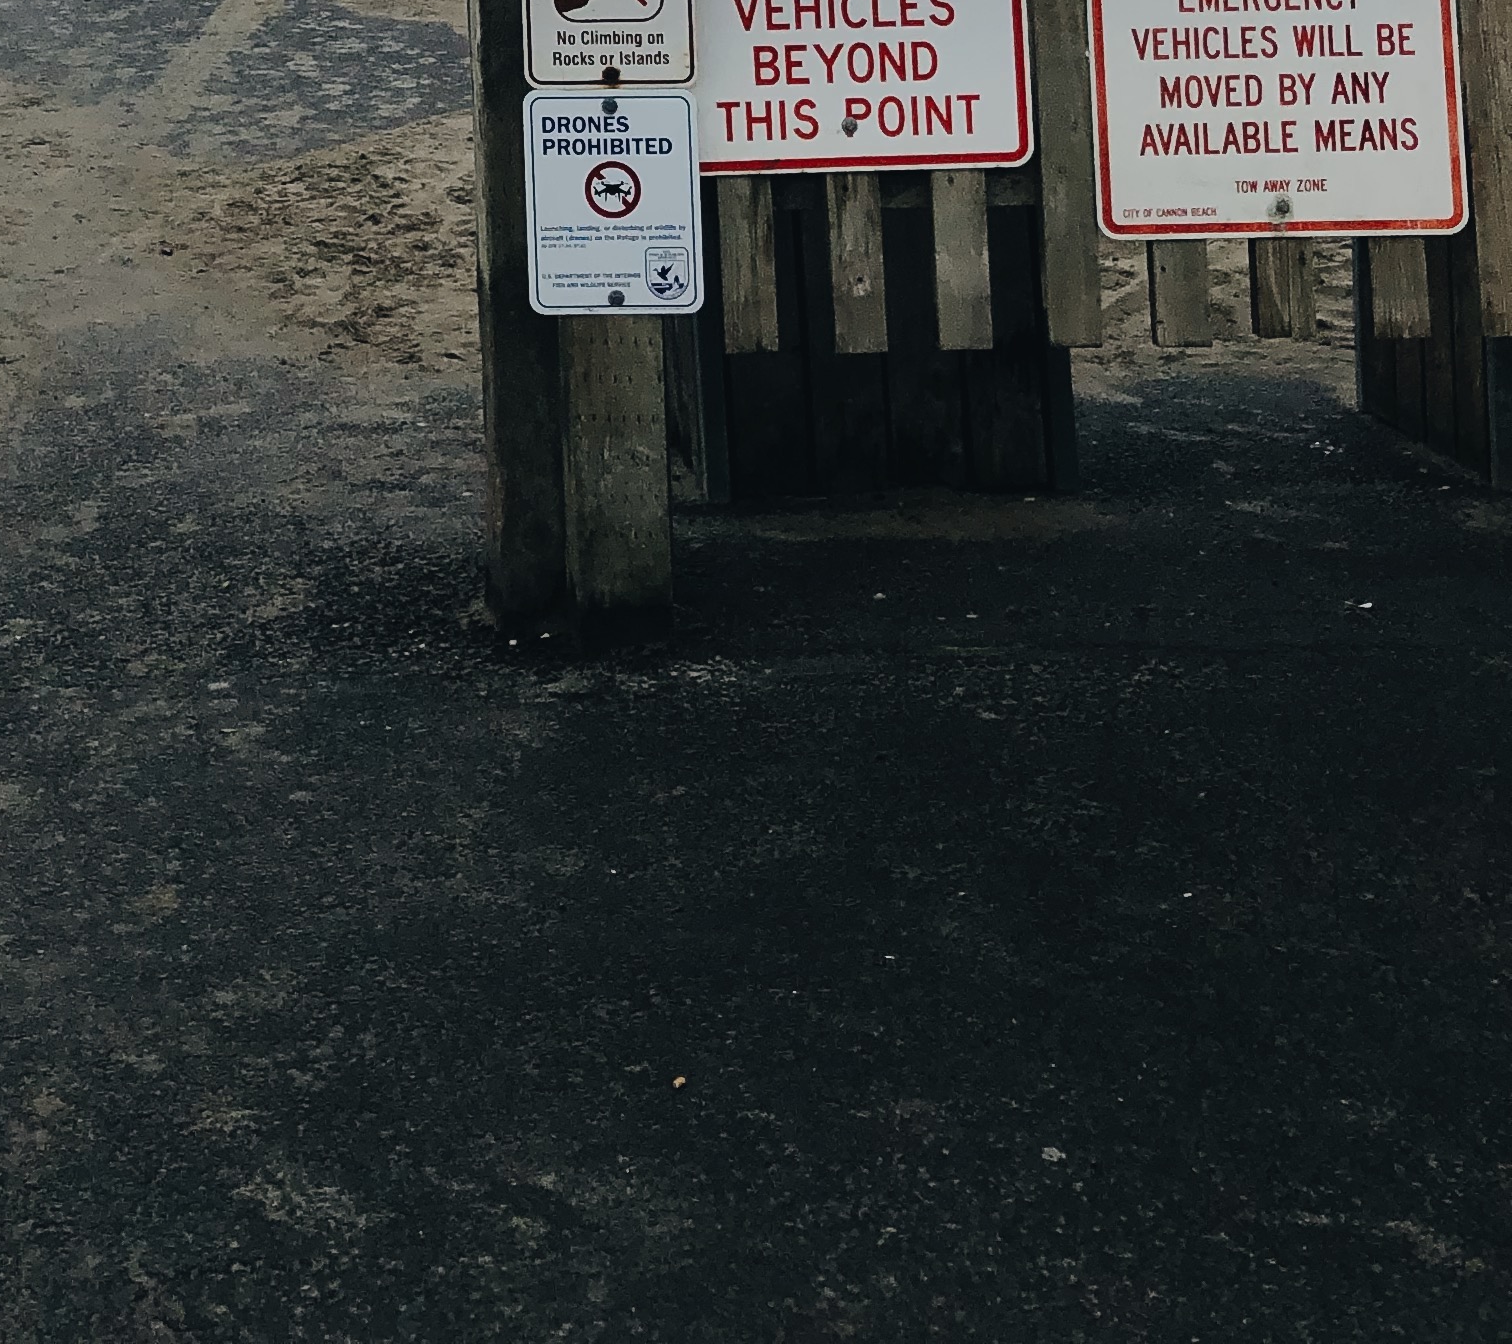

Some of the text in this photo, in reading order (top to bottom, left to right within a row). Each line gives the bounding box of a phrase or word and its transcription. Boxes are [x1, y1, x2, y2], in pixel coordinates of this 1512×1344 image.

[556, 30, 665, 48] No Climbing on
[1130, 22, 1416, 61] VEHICLES WILL BE
[552, 50, 670, 66] Rocks or Islands
[752, 40, 939, 86] BEYOND
[1159, 71, 1390, 109] MOVED BY ANY
[541, 115, 630, 134] DRONES
[716, 93, 981, 142] THIS POINT
[1139, 116, 1419, 157] AVAILABLE MEANS
[542, 137, 673, 156] PROHIBITED
[1234, 178, 1328, 194] TOW AWAY ZONE
[1122, 208, 1141, 219] CITY
[1142, 208, 1153, 218] OF
[1191, 206, 1217, 217] BEACH
